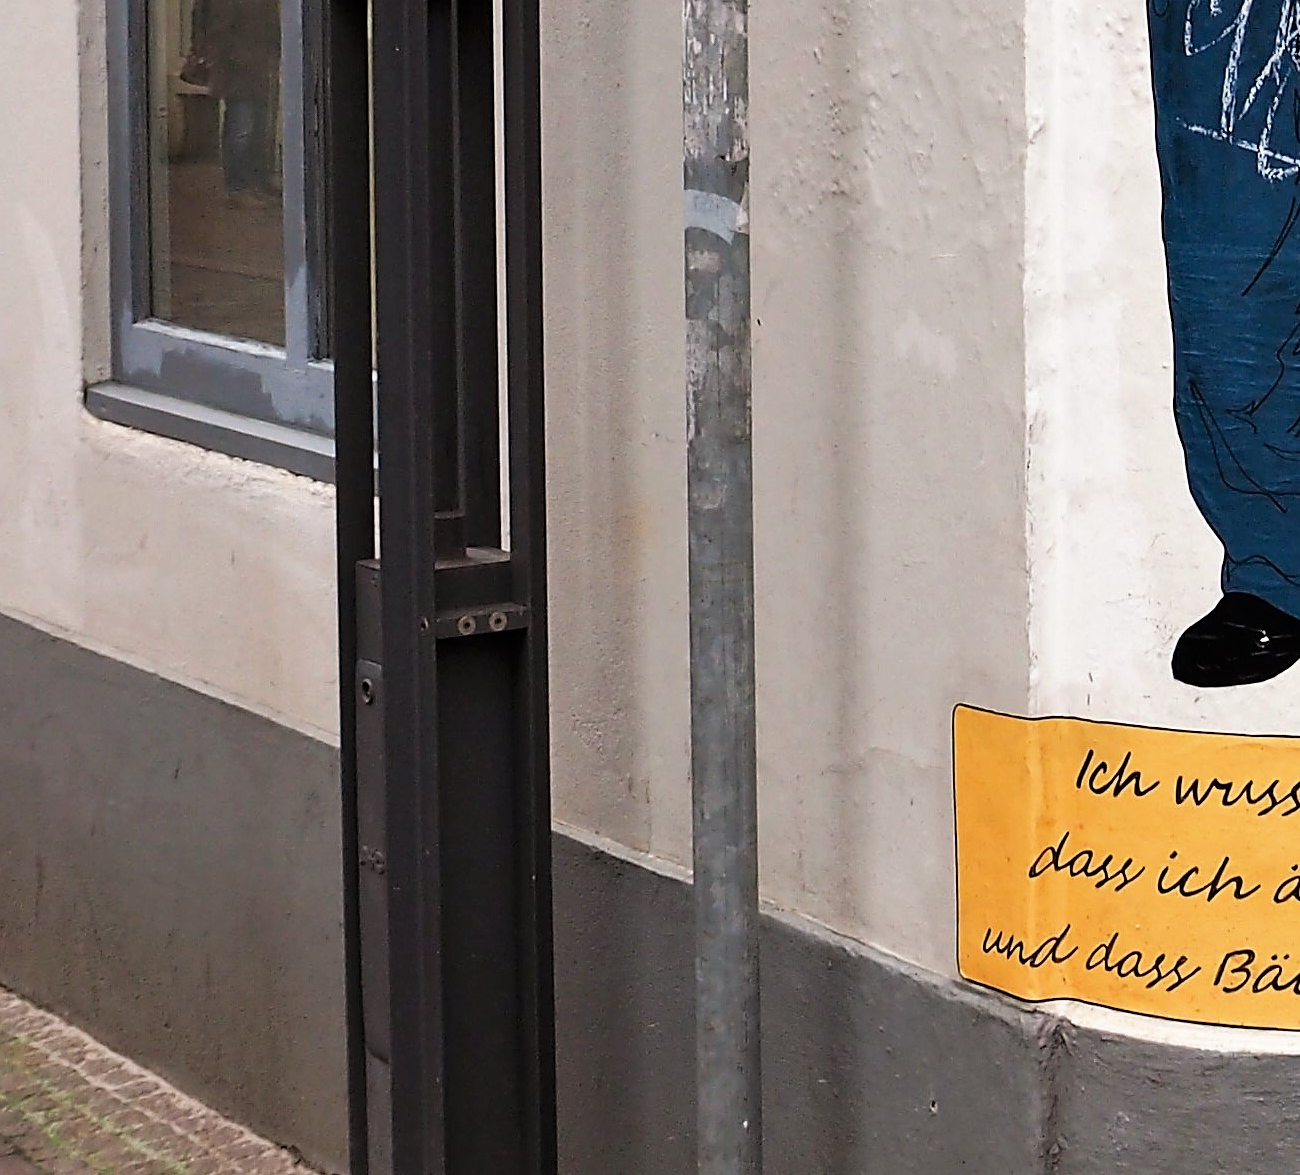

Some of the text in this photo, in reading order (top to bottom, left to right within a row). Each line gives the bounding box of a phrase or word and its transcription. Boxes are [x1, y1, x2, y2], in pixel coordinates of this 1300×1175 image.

[1076, 749, 1160, 798] Ich
[1028, 831, 1146, 892] dass
[1157, 850, 1261, 902] ich
[982, 924, 1079, 968] und
[1085, 932, 1202, 992] dass
